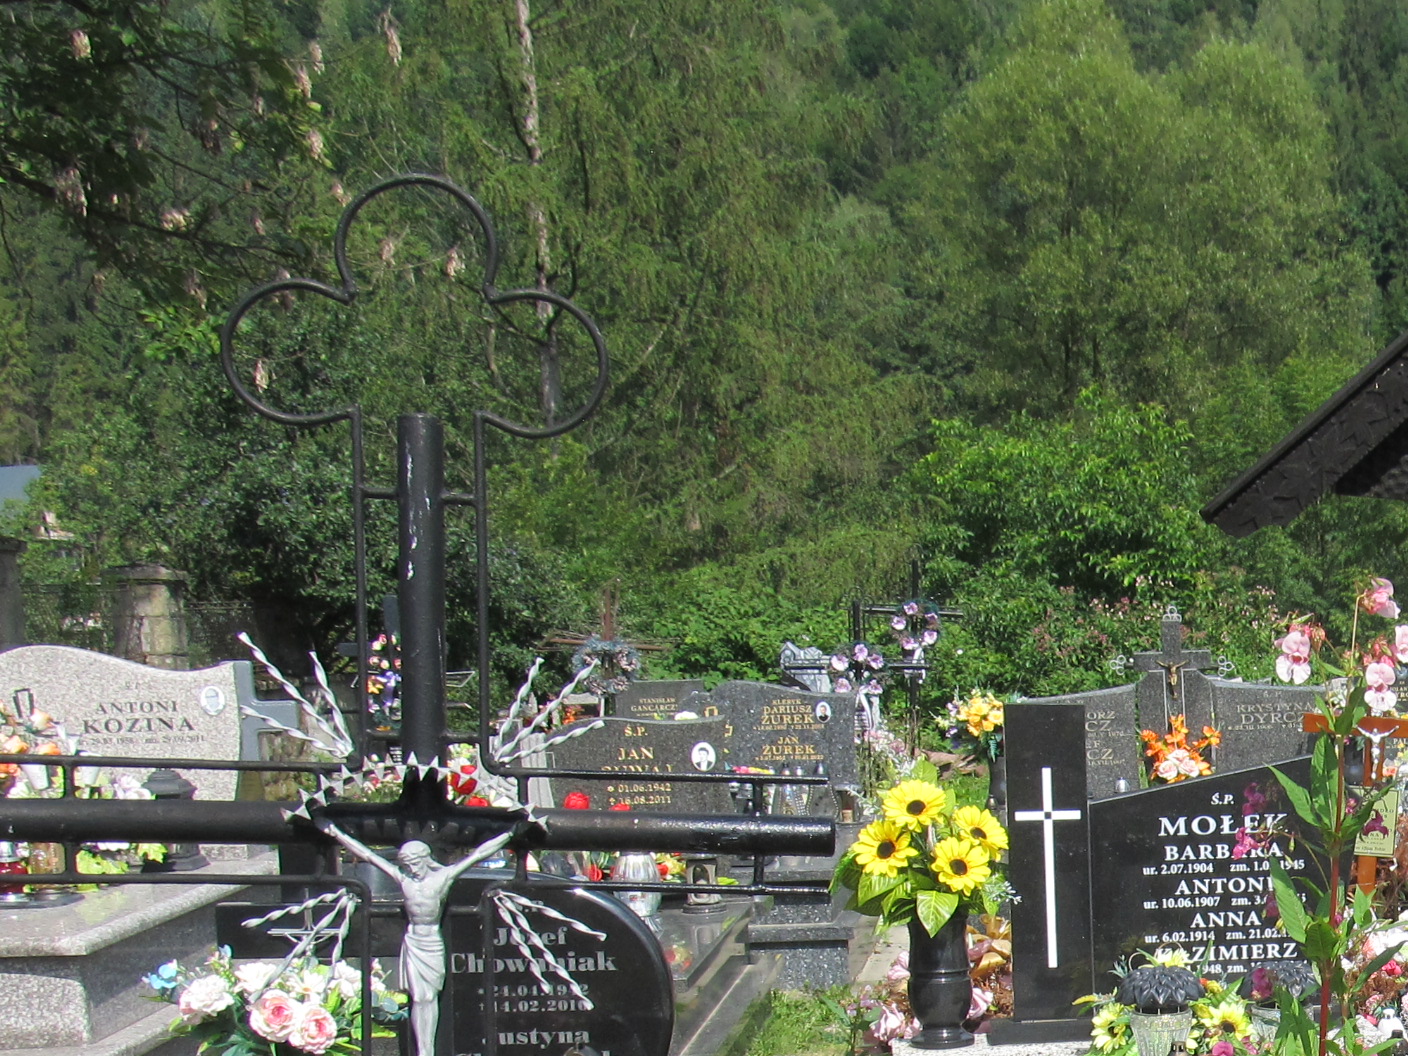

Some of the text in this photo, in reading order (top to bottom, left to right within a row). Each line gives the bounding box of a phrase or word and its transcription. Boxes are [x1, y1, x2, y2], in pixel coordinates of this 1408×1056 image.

[96, 700, 178, 715] ANTONI
[763, 705, 812, 715] DARIUSZ
[1236, 702, 1314, 713] KRYSTYNA
[83, 717, 195, 734] KOZINA
[778, 736, 800, 745] JAN
[618, 747, 655, 761] JAN
[762, 743, 816, 755] ŻUREK
[1211, 792, 1234, 805] Ś.P.
[1158, 813, 1287, 837] MOŁEK
[1143, 867, 1158, 875] ur.
[1161, 863, 1213, 874] 2.07.1904
[1230, 864, 1251, 872] zm.
[1162, 896, 1220, 909] 10.06.1907
[1231, 897, 1251, 906] zm.
[1190, 911, 1261, 928] ANNA
[1145, 935, 1160, 943] ur.
[1162, 931, 1215, 942] 6.02.1914
[1225, 931, 1246, 940] zm.
[1227, 964, 1248, 973] zm.
